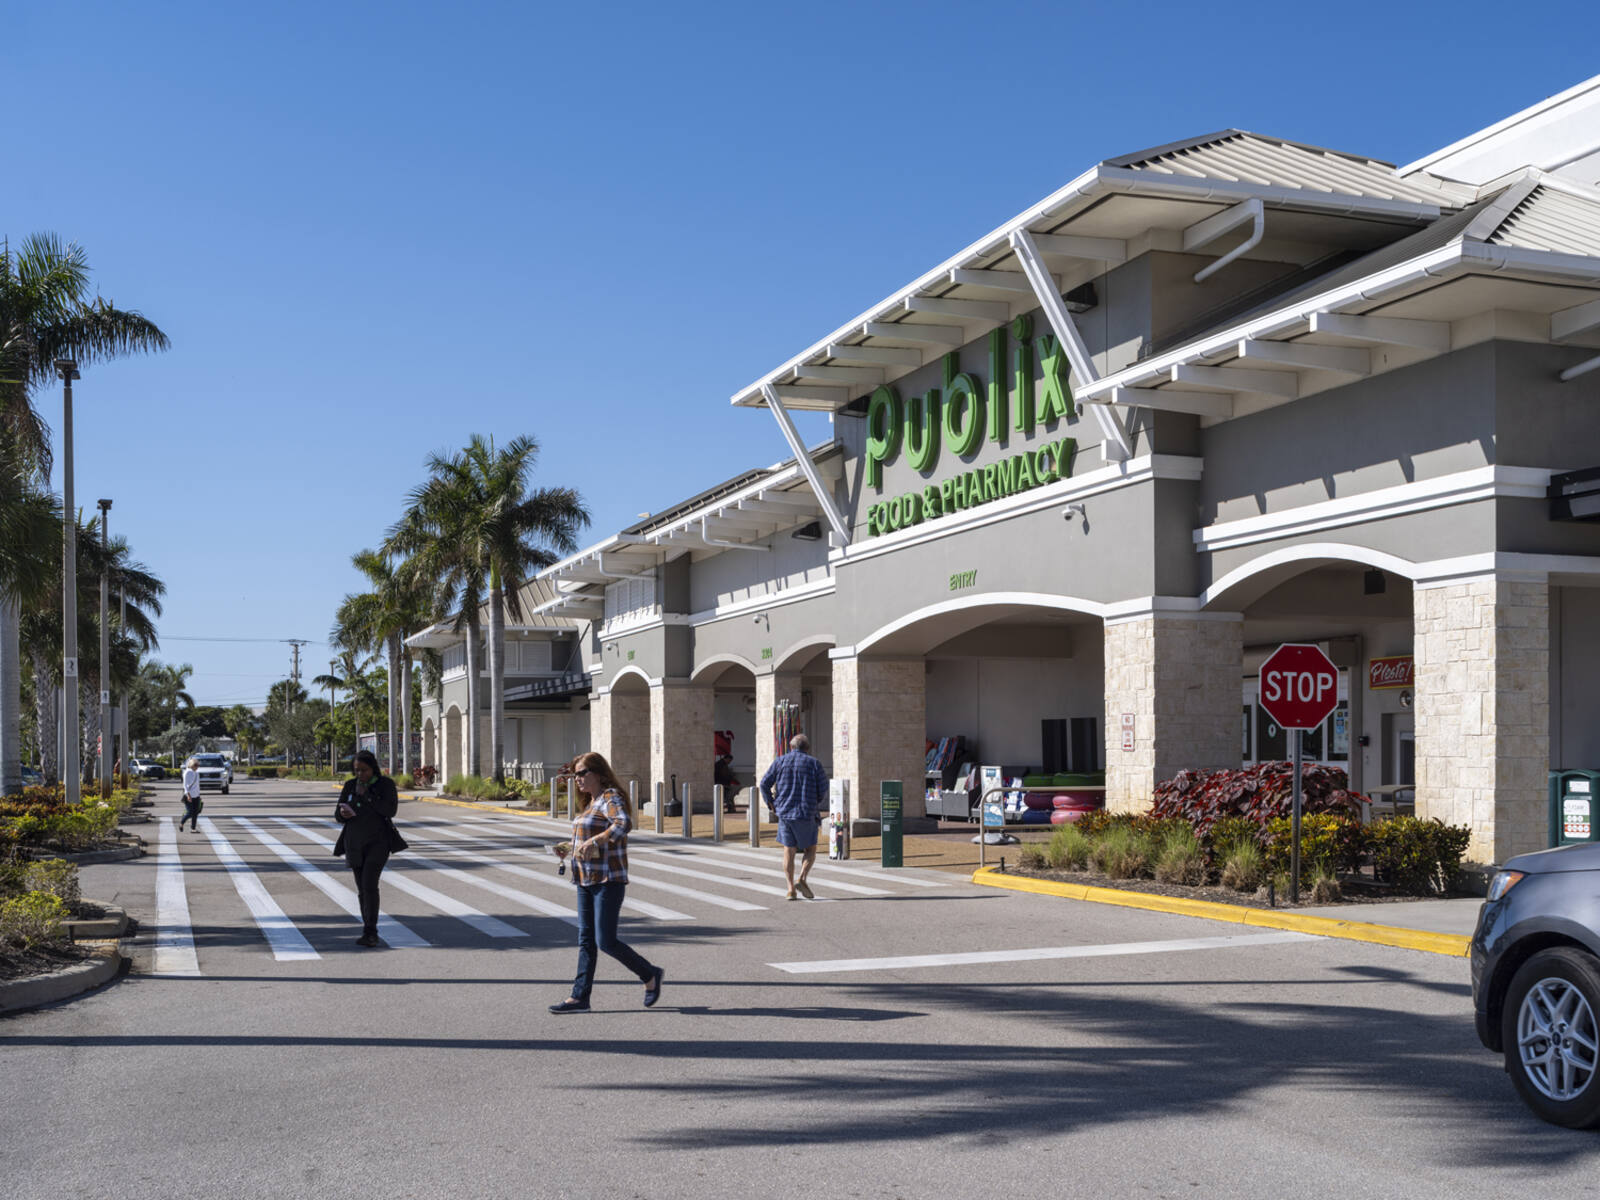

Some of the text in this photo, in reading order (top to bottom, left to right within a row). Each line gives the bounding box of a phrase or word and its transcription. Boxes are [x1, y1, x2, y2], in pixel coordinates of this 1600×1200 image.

[866, 314, 1076, 488] Publix
[867, 437, 1076, 536] FOOD & PHARMACY
[949, 569, 977, 591] ENTRY
[1265, 670, 1334, 703] STOP
